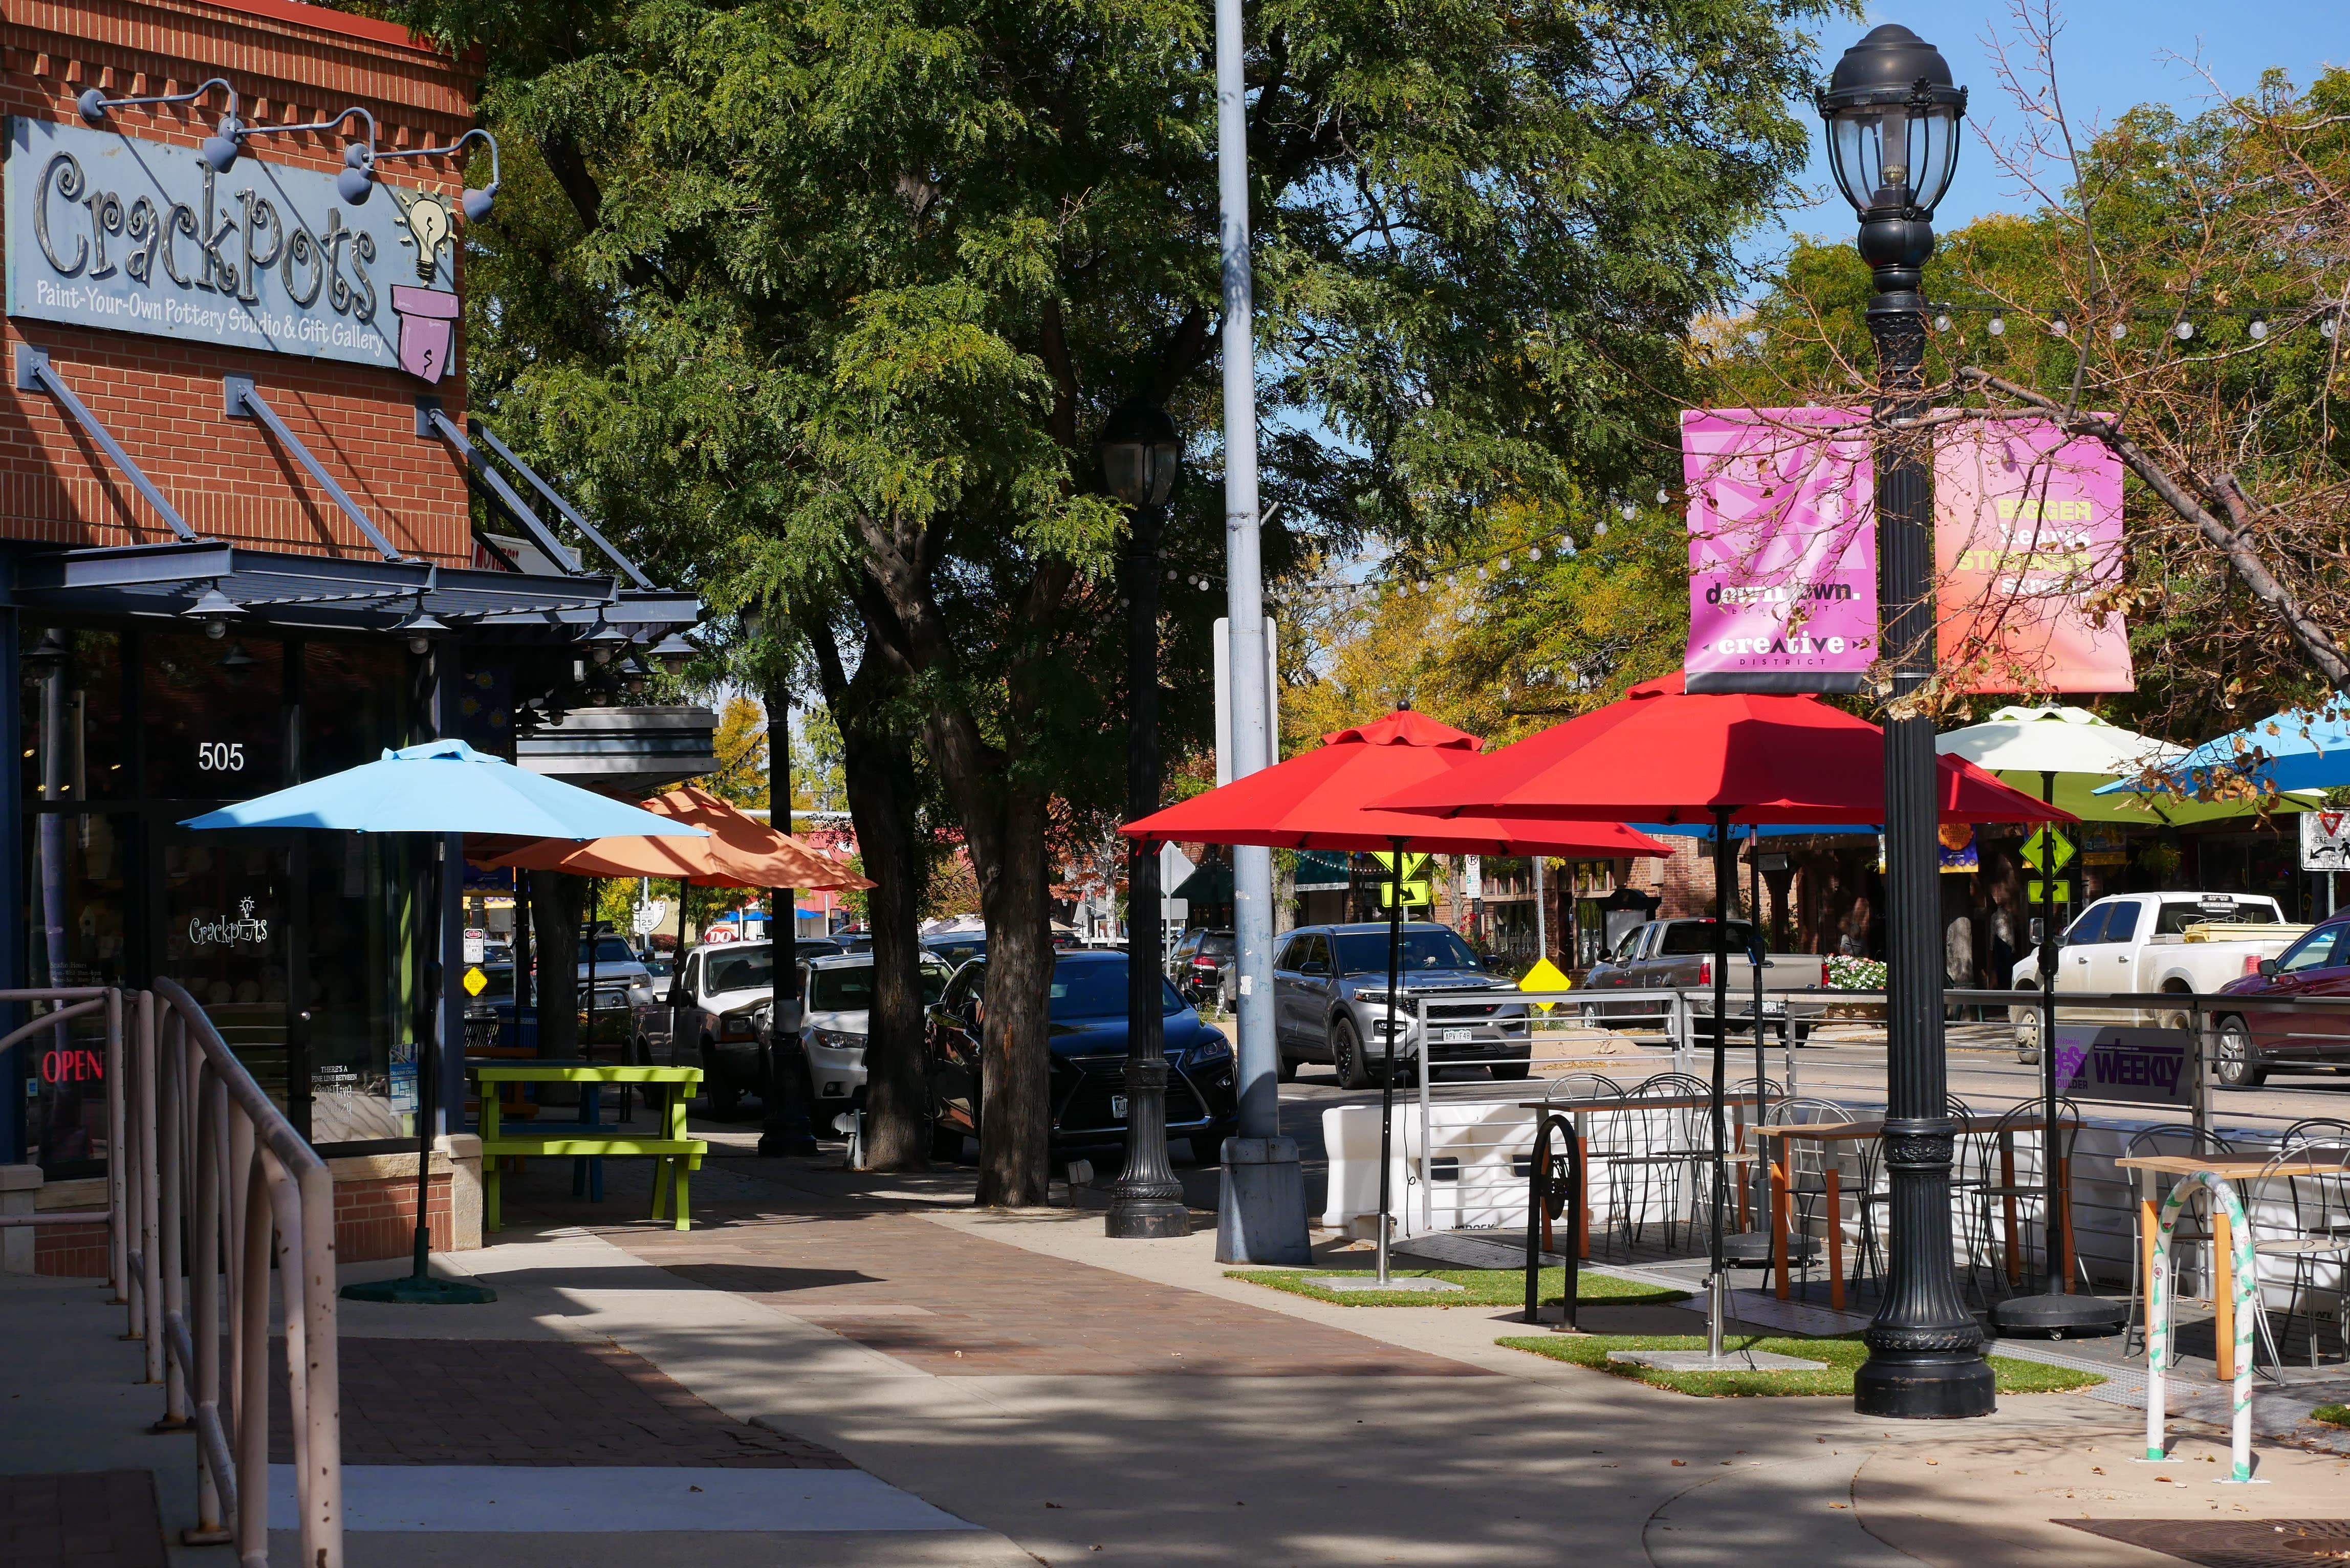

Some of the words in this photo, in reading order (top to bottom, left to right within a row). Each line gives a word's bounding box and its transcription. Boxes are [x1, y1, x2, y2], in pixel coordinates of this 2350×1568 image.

[37, 280, 163, 321] Paint-Your-Own
[165, 301, 226, 335] Pottery
[228, 307, 281, 338] Studio
[284, 316, 297, 339] &
[298, 316, 331, 343] Gift
[332, 322, 383, 357] Gallery
[1998, 499, 2092, 520] BIGGER
[1999, 524, 2091, 547] hearts
[1706, 581, 1861, 604] downtown.
[199, 743, 244, 771] 505
[709, 931, 731, 943] DQ
[42, 1050, 103, 1082] OPEN
[2094, 1052, 2183, 1096] WEEKLY
[2055, 1079, 2088, 1090] OULDER
